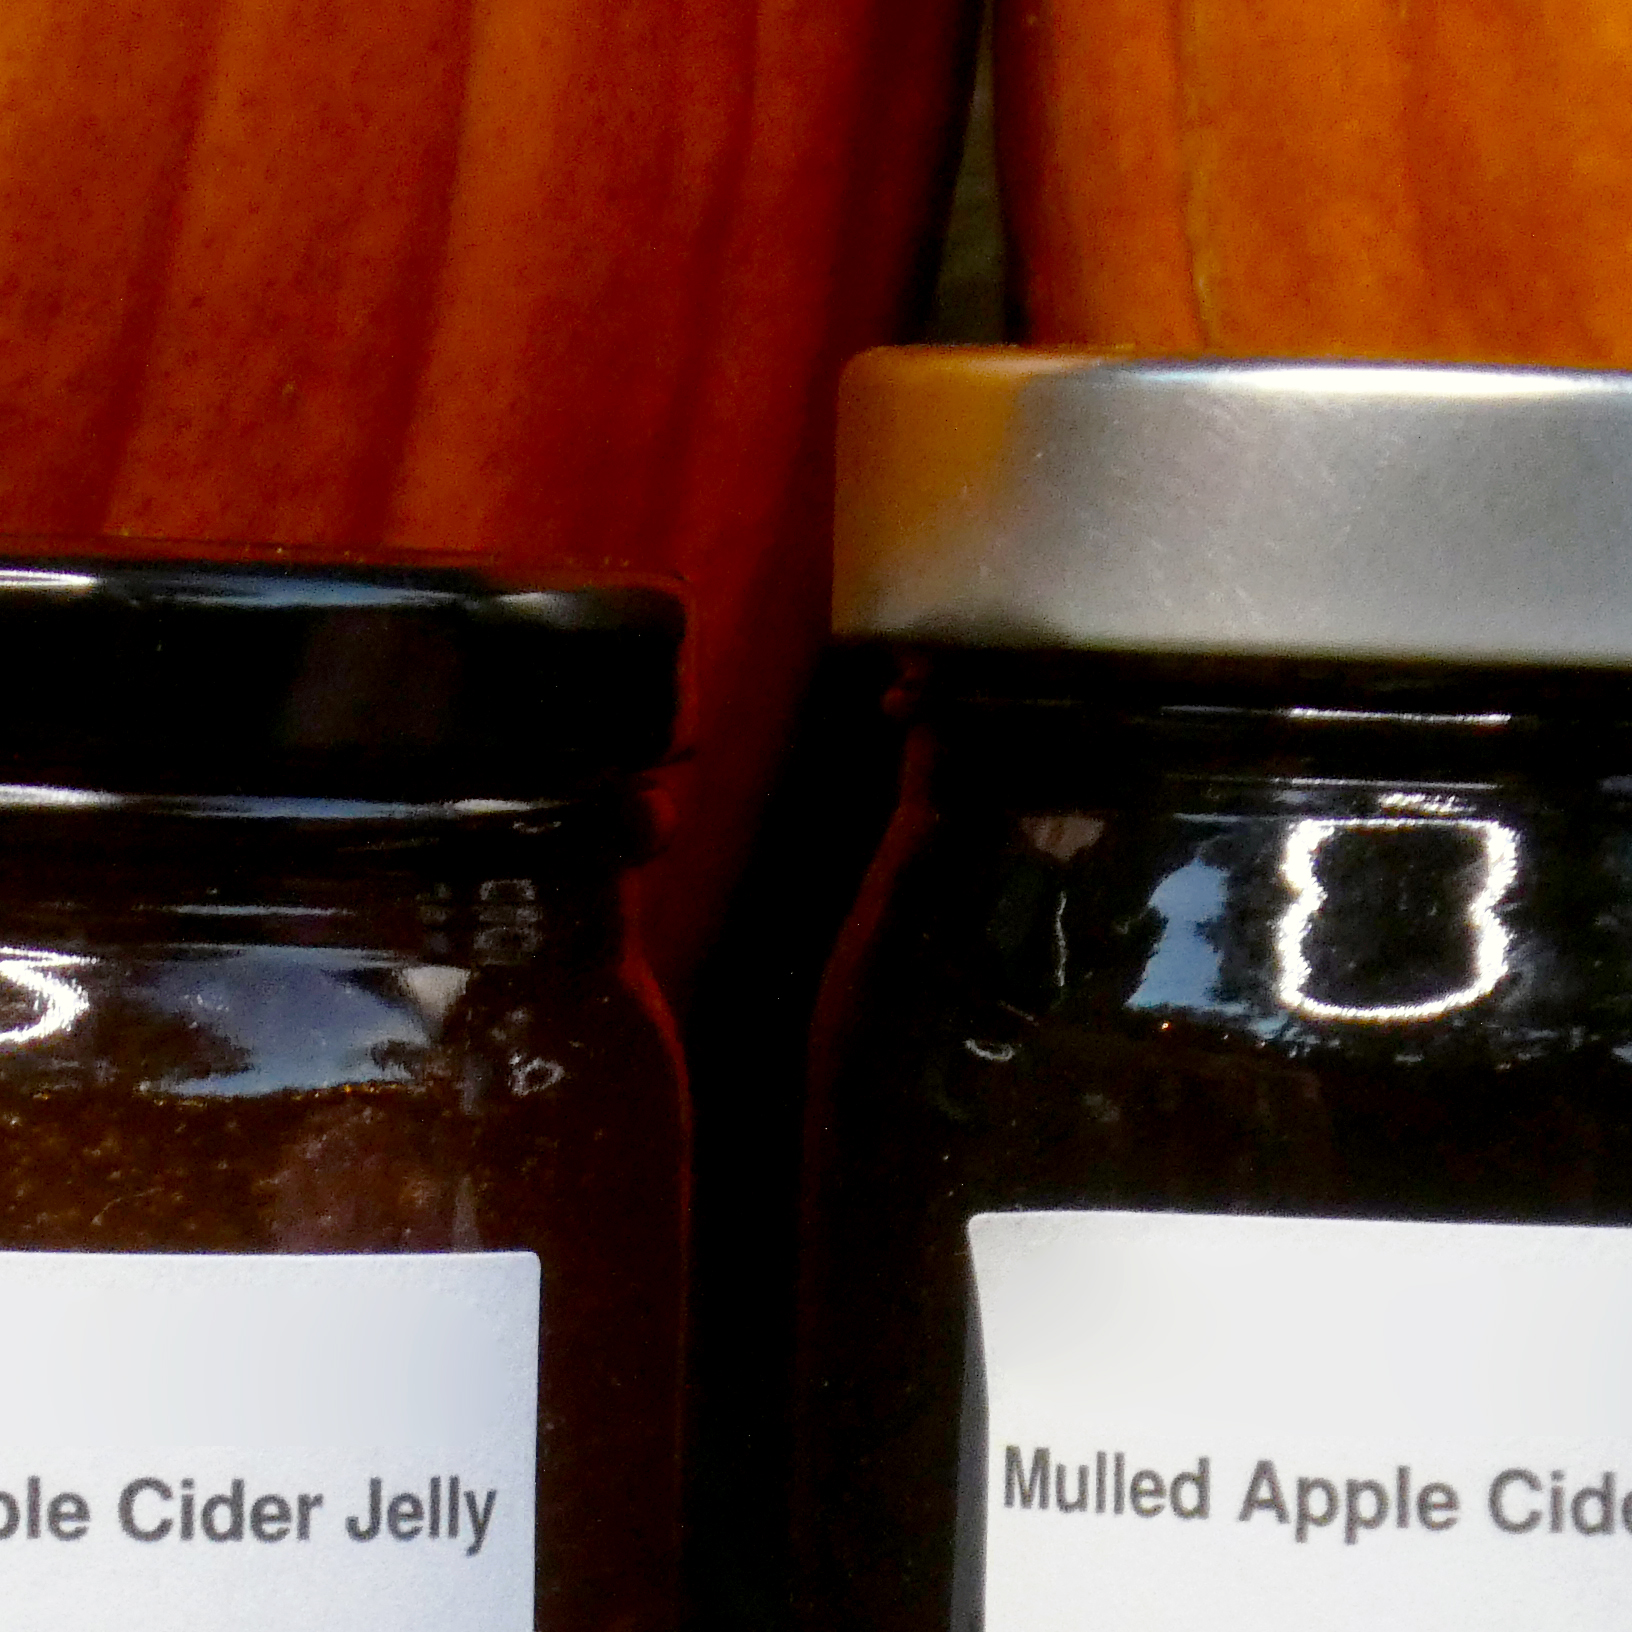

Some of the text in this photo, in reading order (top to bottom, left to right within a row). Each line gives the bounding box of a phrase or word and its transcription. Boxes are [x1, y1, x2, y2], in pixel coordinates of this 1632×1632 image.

[117, 1477, 324, 1544] Cider
[345, 1474, 498, 1558] Jelly
[1004, 1445, 1210, 1520] Mulled
[1237, 1459, 1460, 1546] Apple
